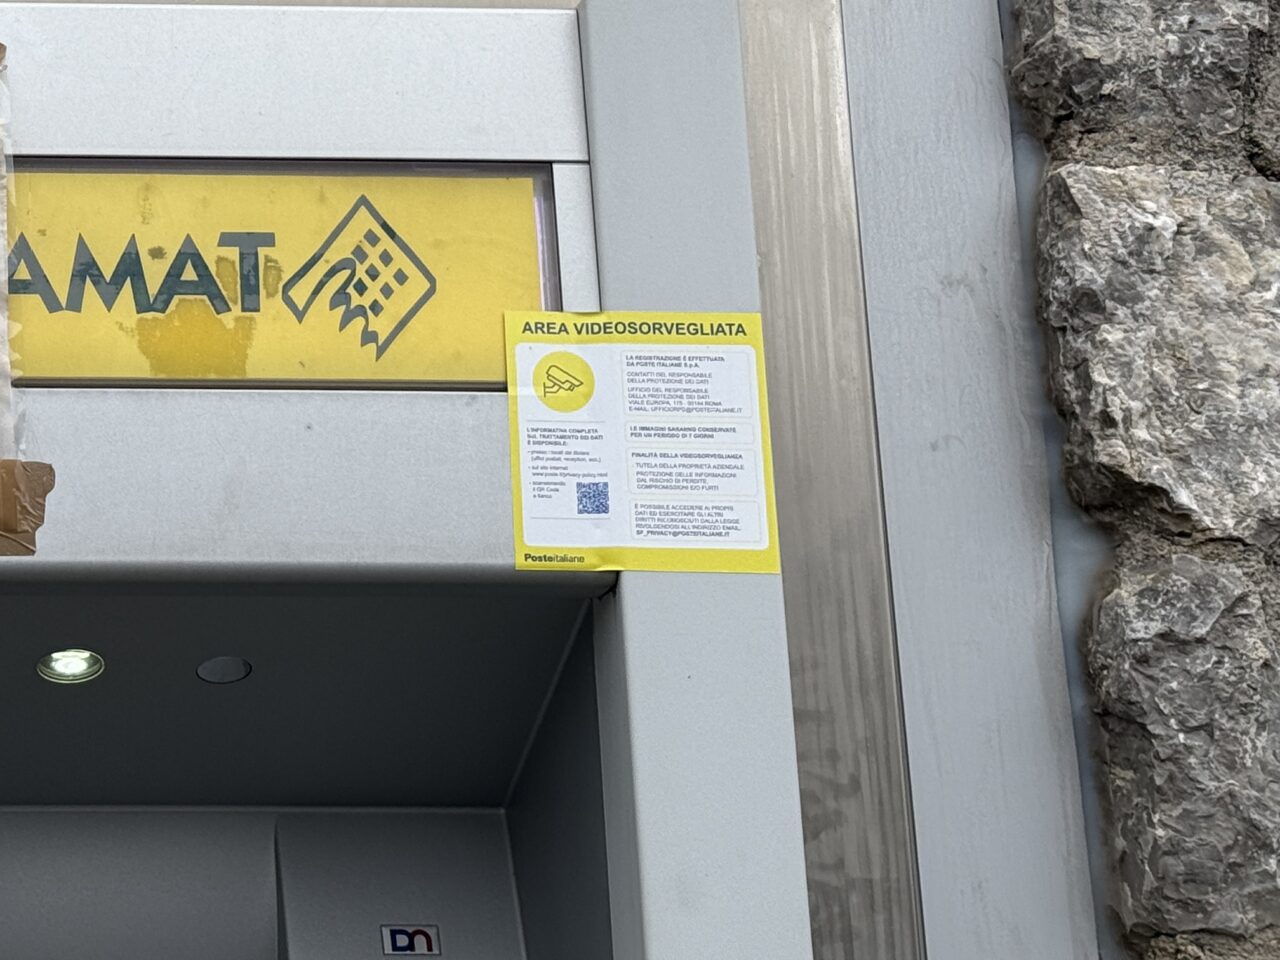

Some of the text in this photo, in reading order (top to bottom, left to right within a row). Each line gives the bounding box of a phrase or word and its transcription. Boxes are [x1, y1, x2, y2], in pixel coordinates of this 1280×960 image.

[522, 322, 747, 336] AREA VIDEOSORVEGLIATA
[524, 554, 584, 562] Posteitaliane
